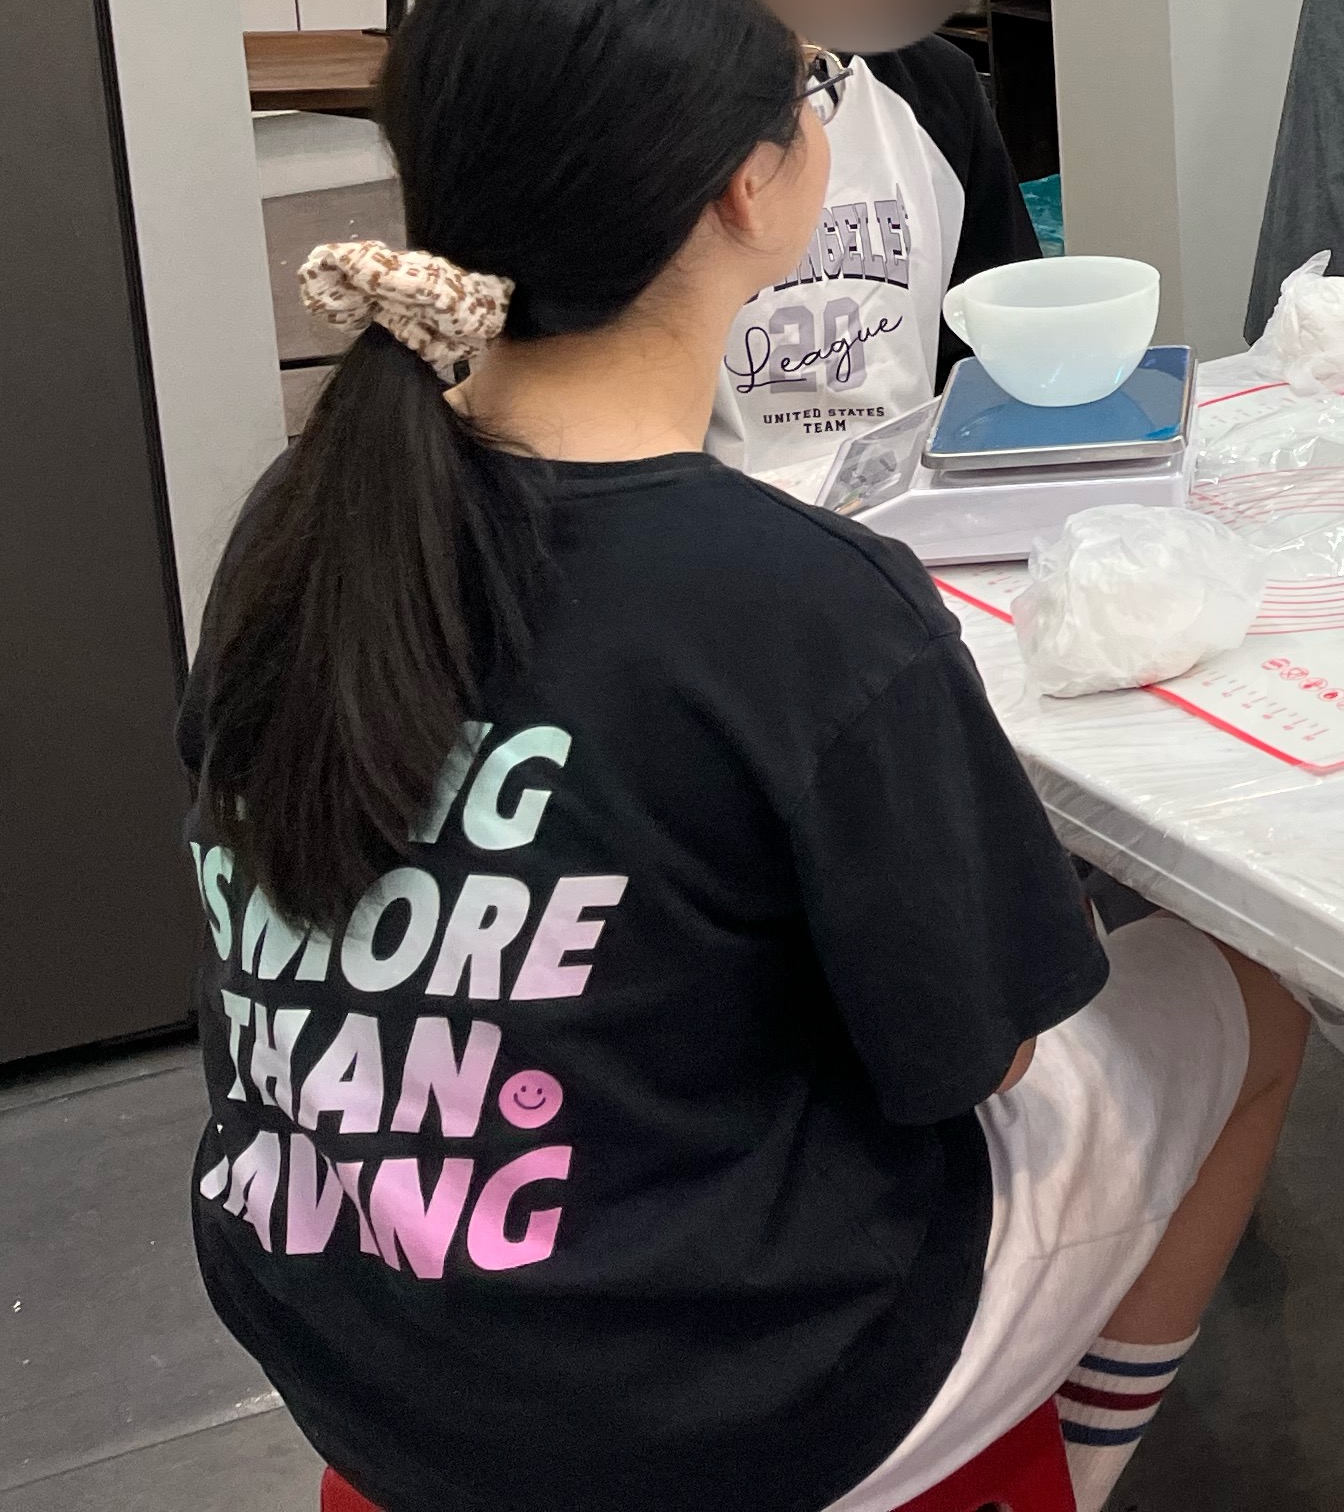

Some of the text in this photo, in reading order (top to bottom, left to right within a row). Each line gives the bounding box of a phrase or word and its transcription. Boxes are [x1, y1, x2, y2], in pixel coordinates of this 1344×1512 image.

[723, 315, 904, 394] League
[763, 406, 885, 424] UNITED STATES
[803, 419, 847, 435] TEAM
[242, 867, 629, 1001] MORE
[220, 988, 502, 1138] THAN
